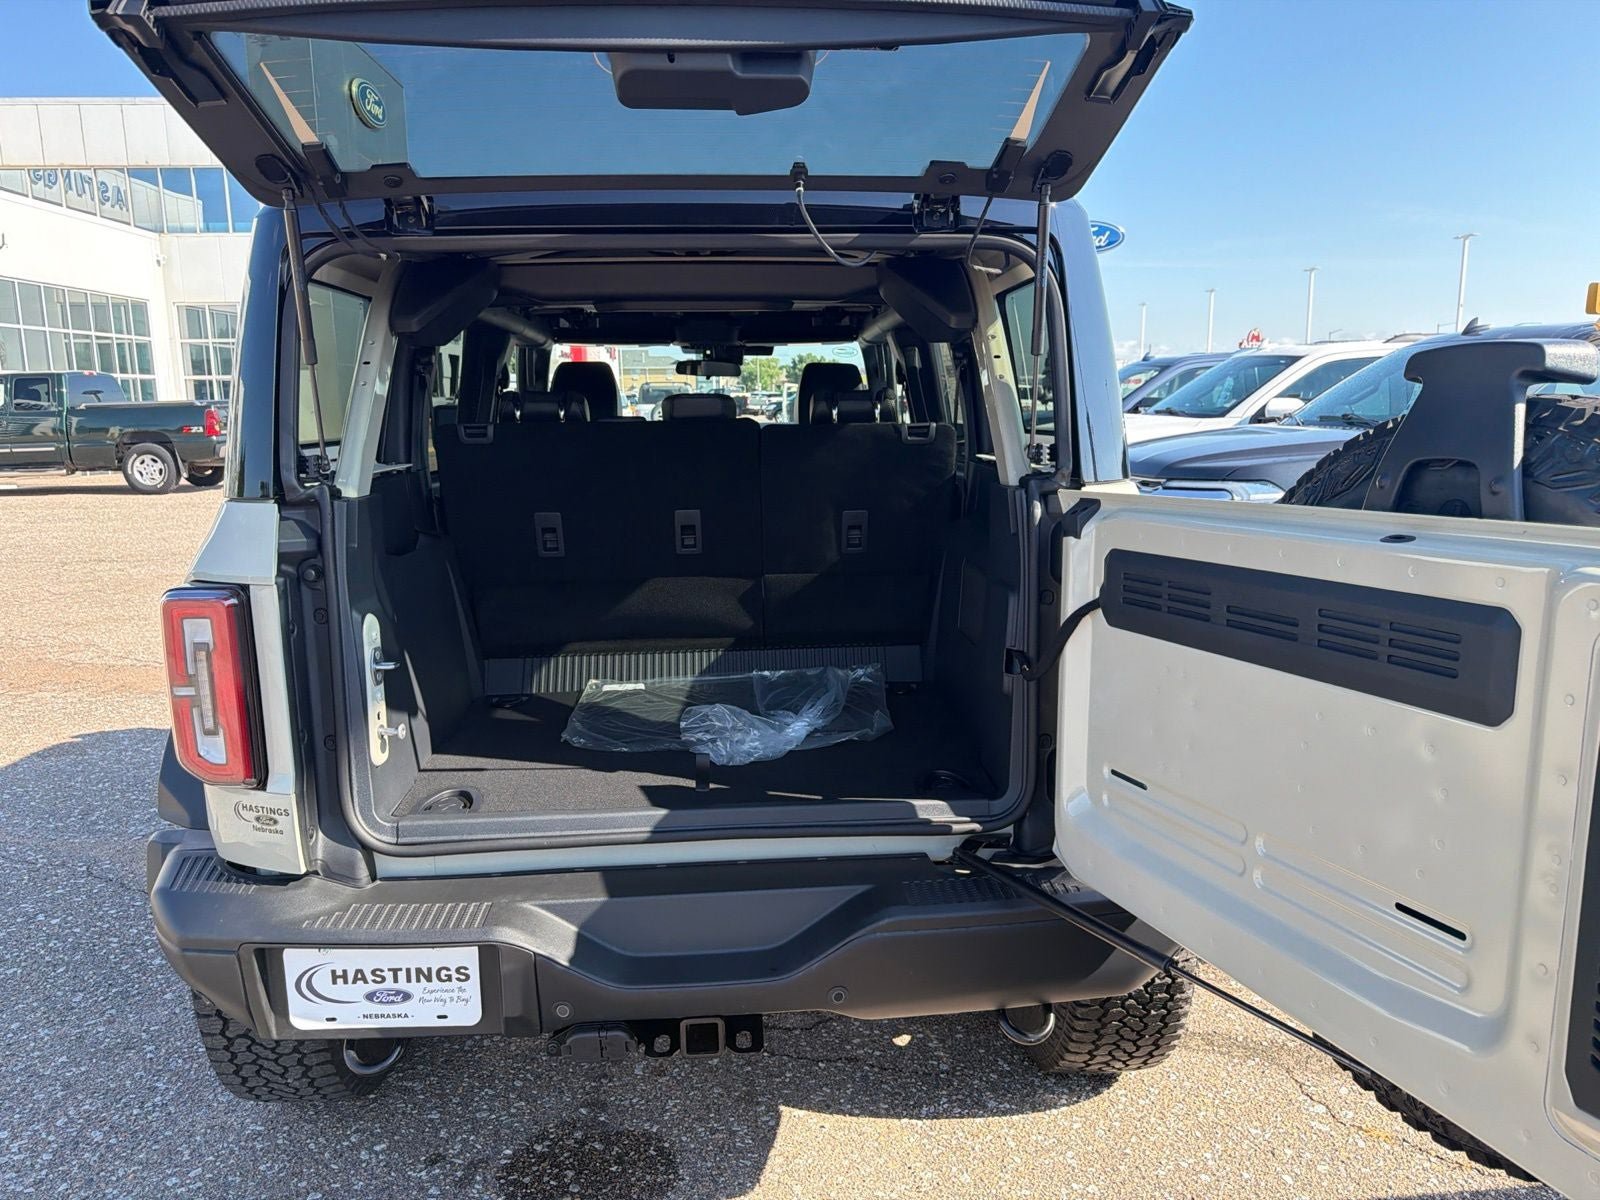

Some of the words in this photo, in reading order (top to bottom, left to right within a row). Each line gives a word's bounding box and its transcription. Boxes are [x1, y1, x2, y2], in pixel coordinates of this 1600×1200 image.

[241, 803, 290, 817] HASTINGS
[252, 824, 284, 835] Nebraska
[330, 965, 471, 985] HASTINGS
[422, 987, 455, 995] Experience
[433, 994, 447, 1007] Way
